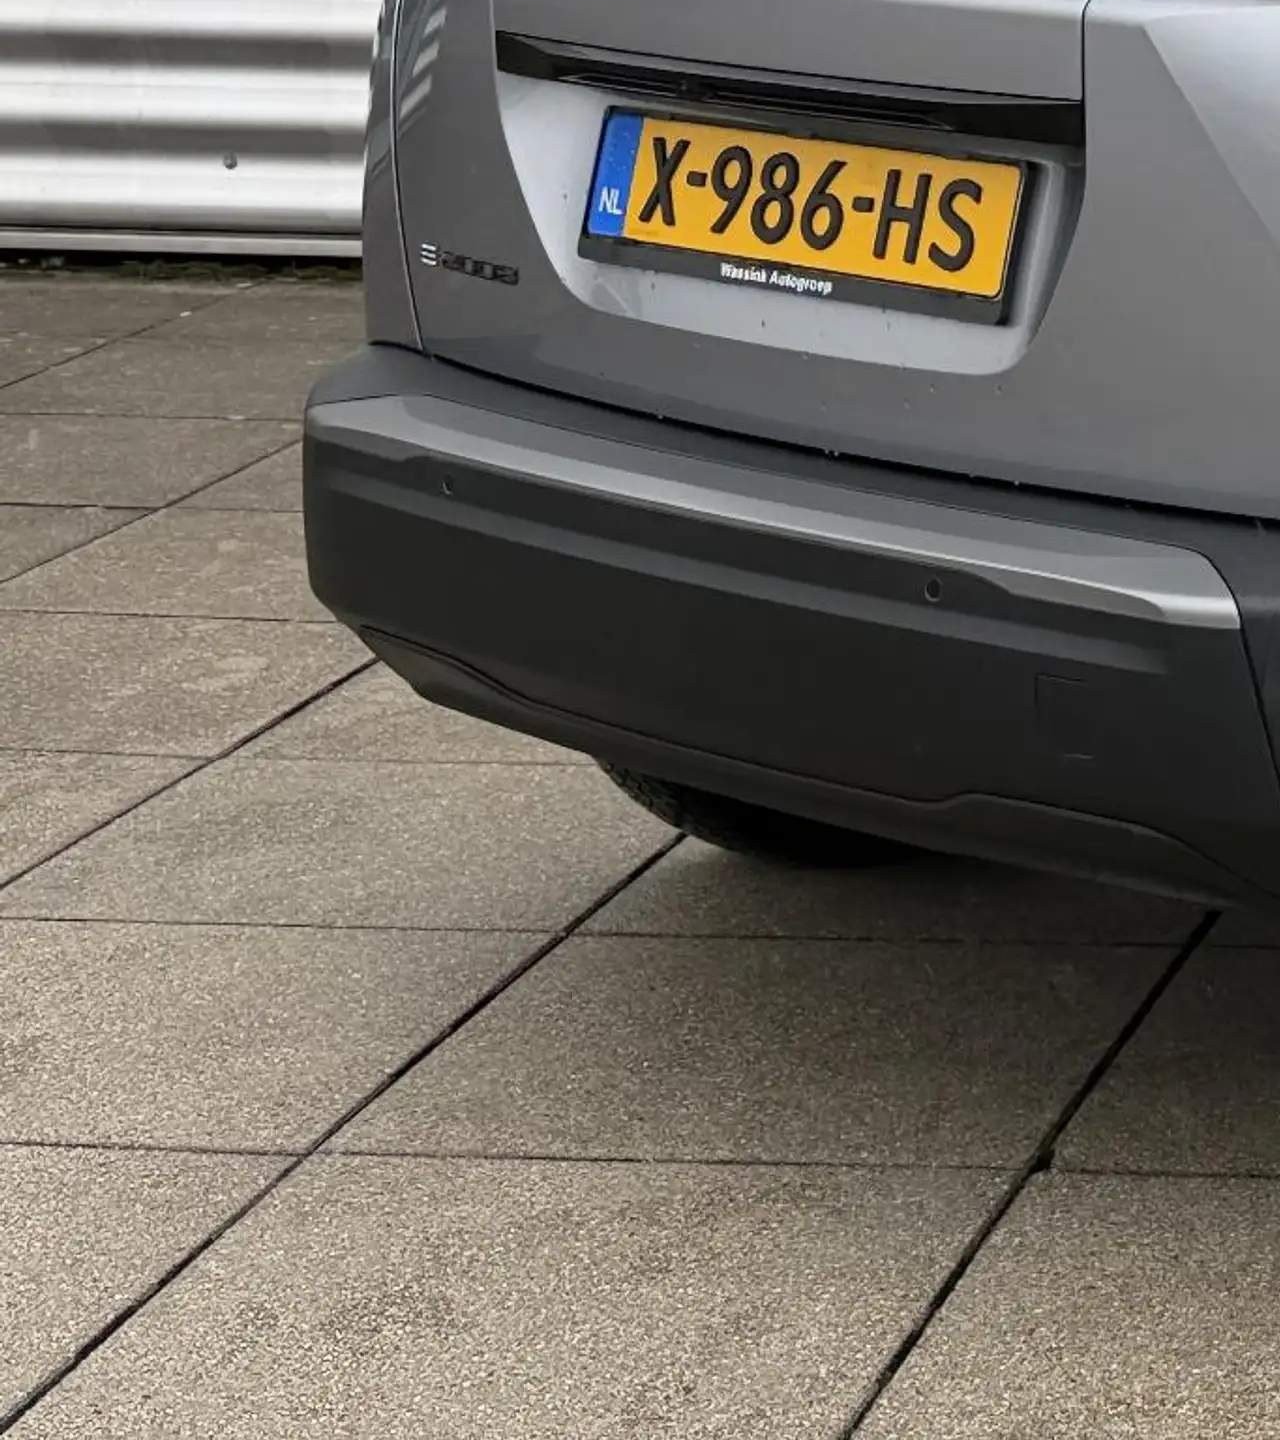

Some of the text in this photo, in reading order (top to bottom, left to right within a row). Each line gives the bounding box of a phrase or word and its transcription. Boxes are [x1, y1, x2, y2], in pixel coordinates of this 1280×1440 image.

[599, 186, 624, 215] NL
[638, 136, 983, 272] X-986-HS
[769, 270, 833, 295] Autogroep
